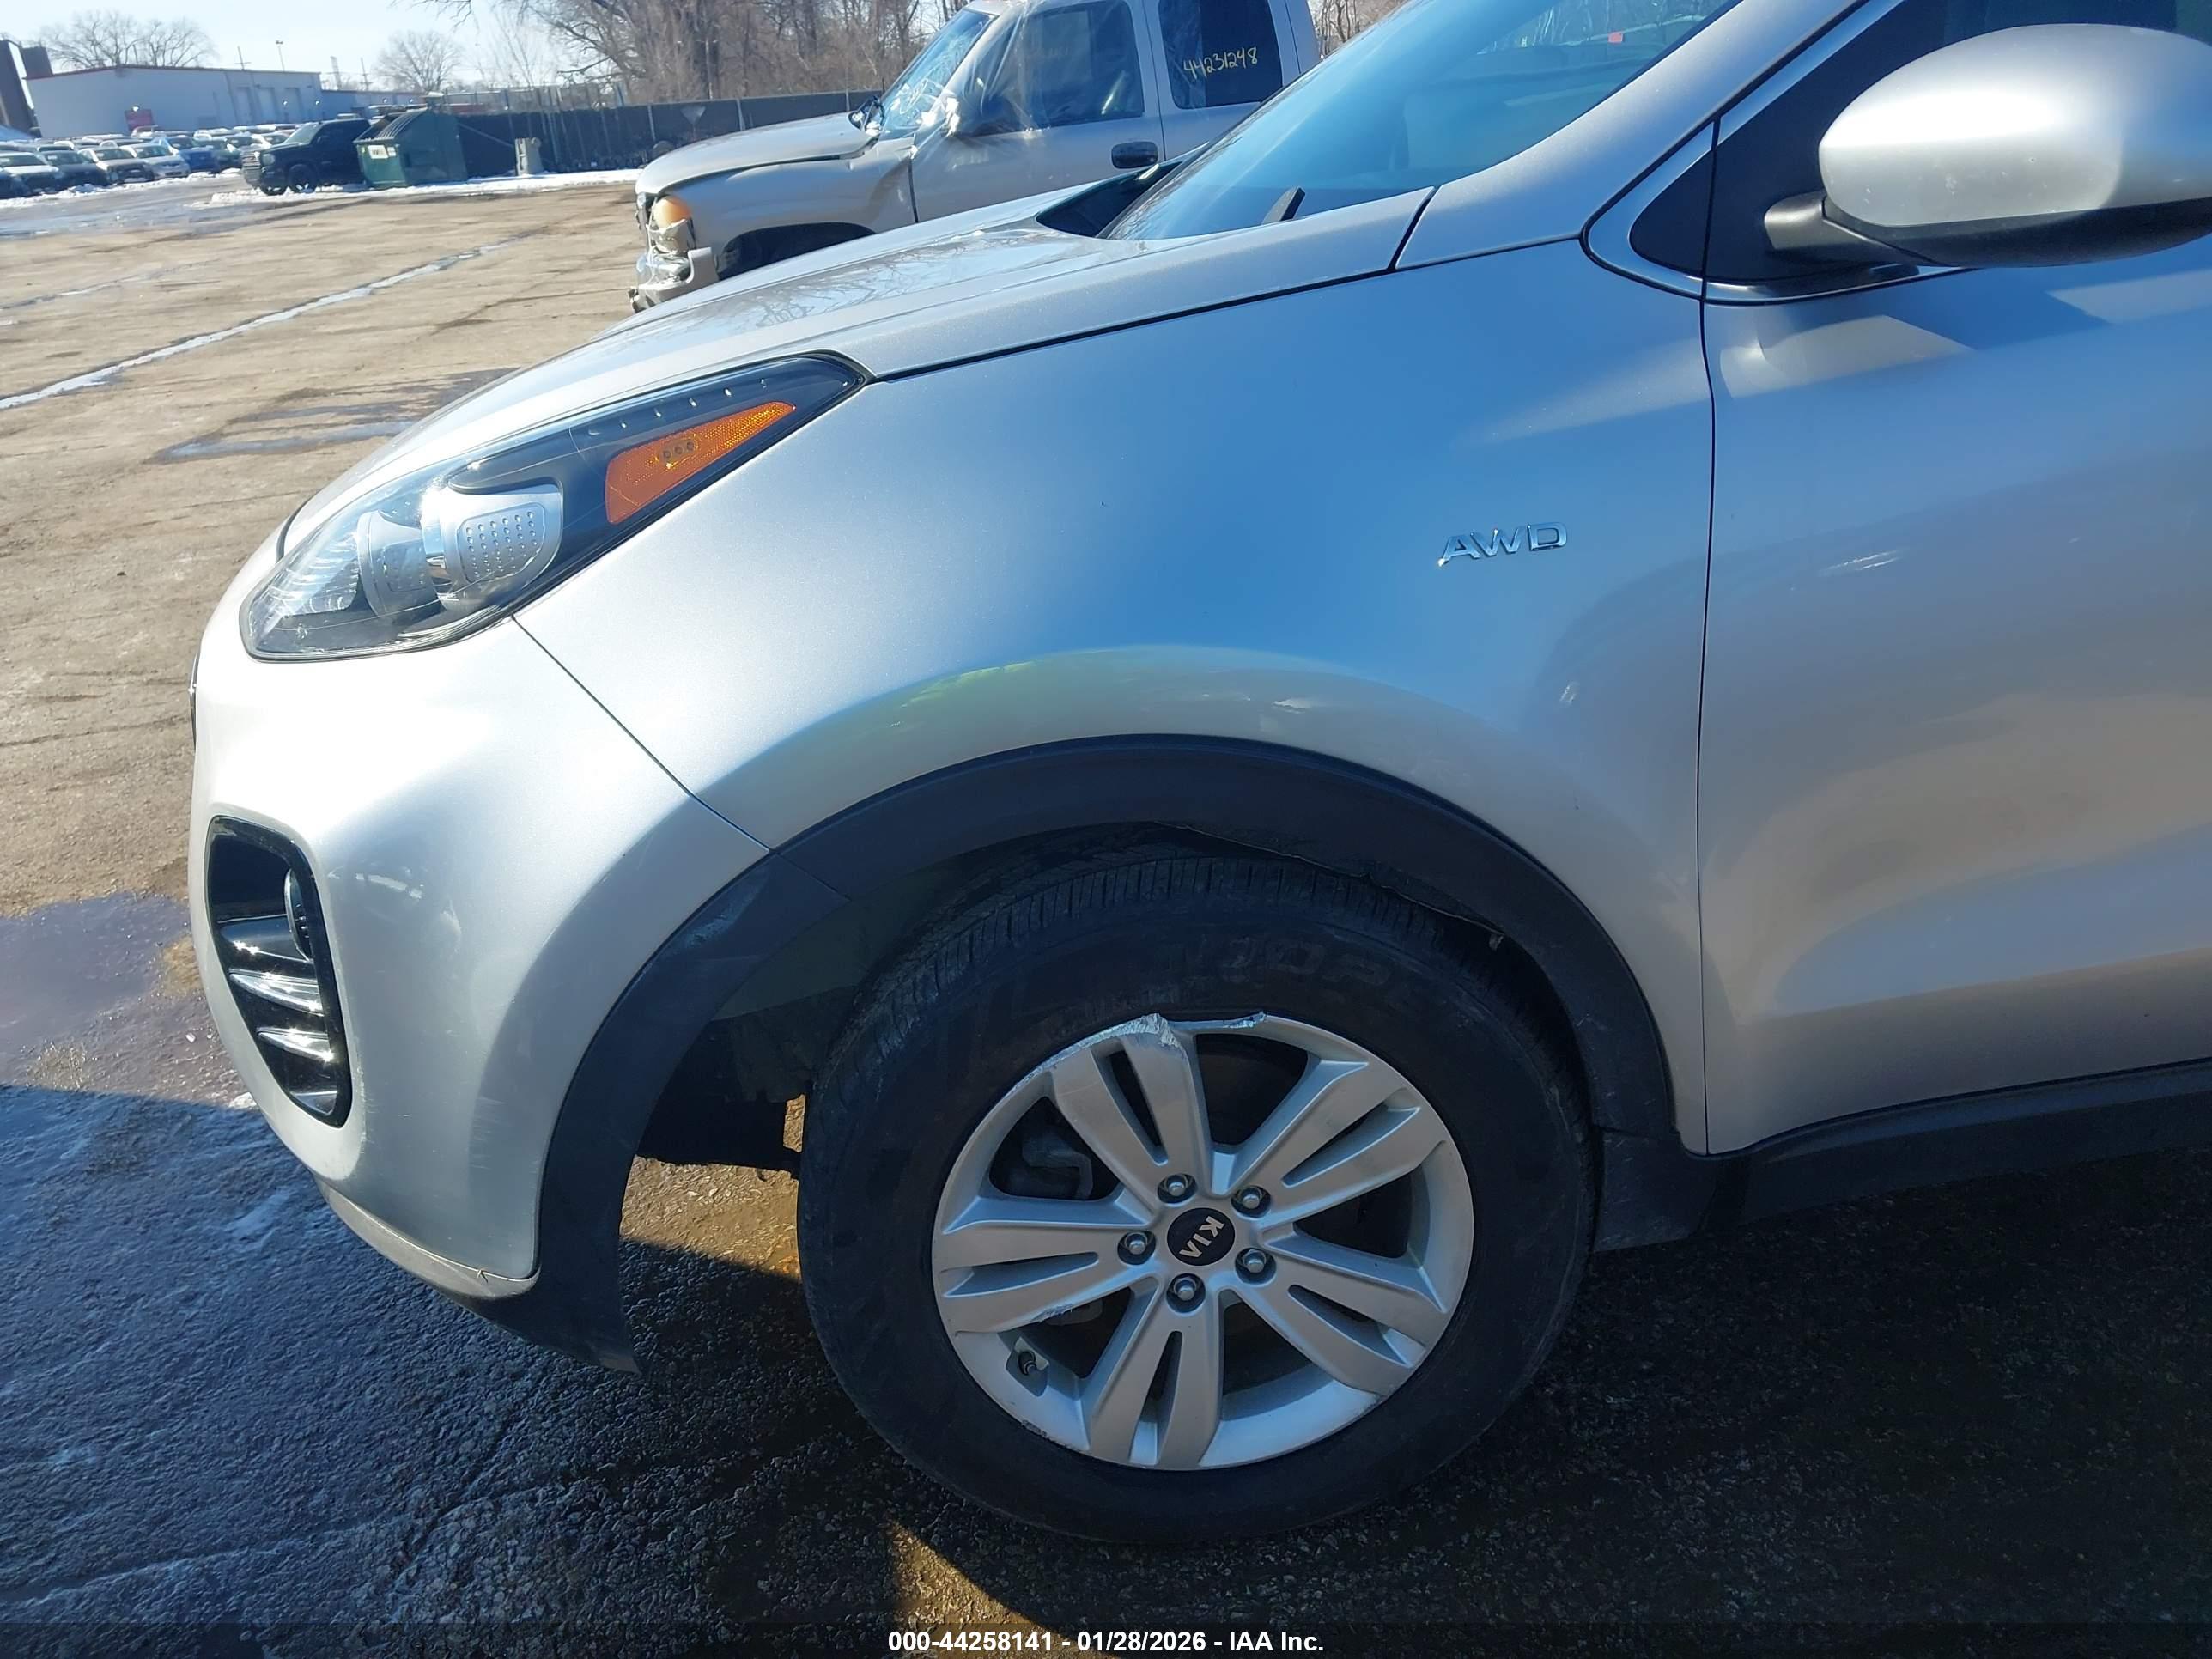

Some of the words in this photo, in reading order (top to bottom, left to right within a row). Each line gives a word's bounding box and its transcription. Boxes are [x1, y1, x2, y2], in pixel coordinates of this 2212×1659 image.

[1183, 46, 1258, 79] 44231248
[1437, 521, 1567, 567] AWD
[1179, 1216, 1224, 1258] KIA
